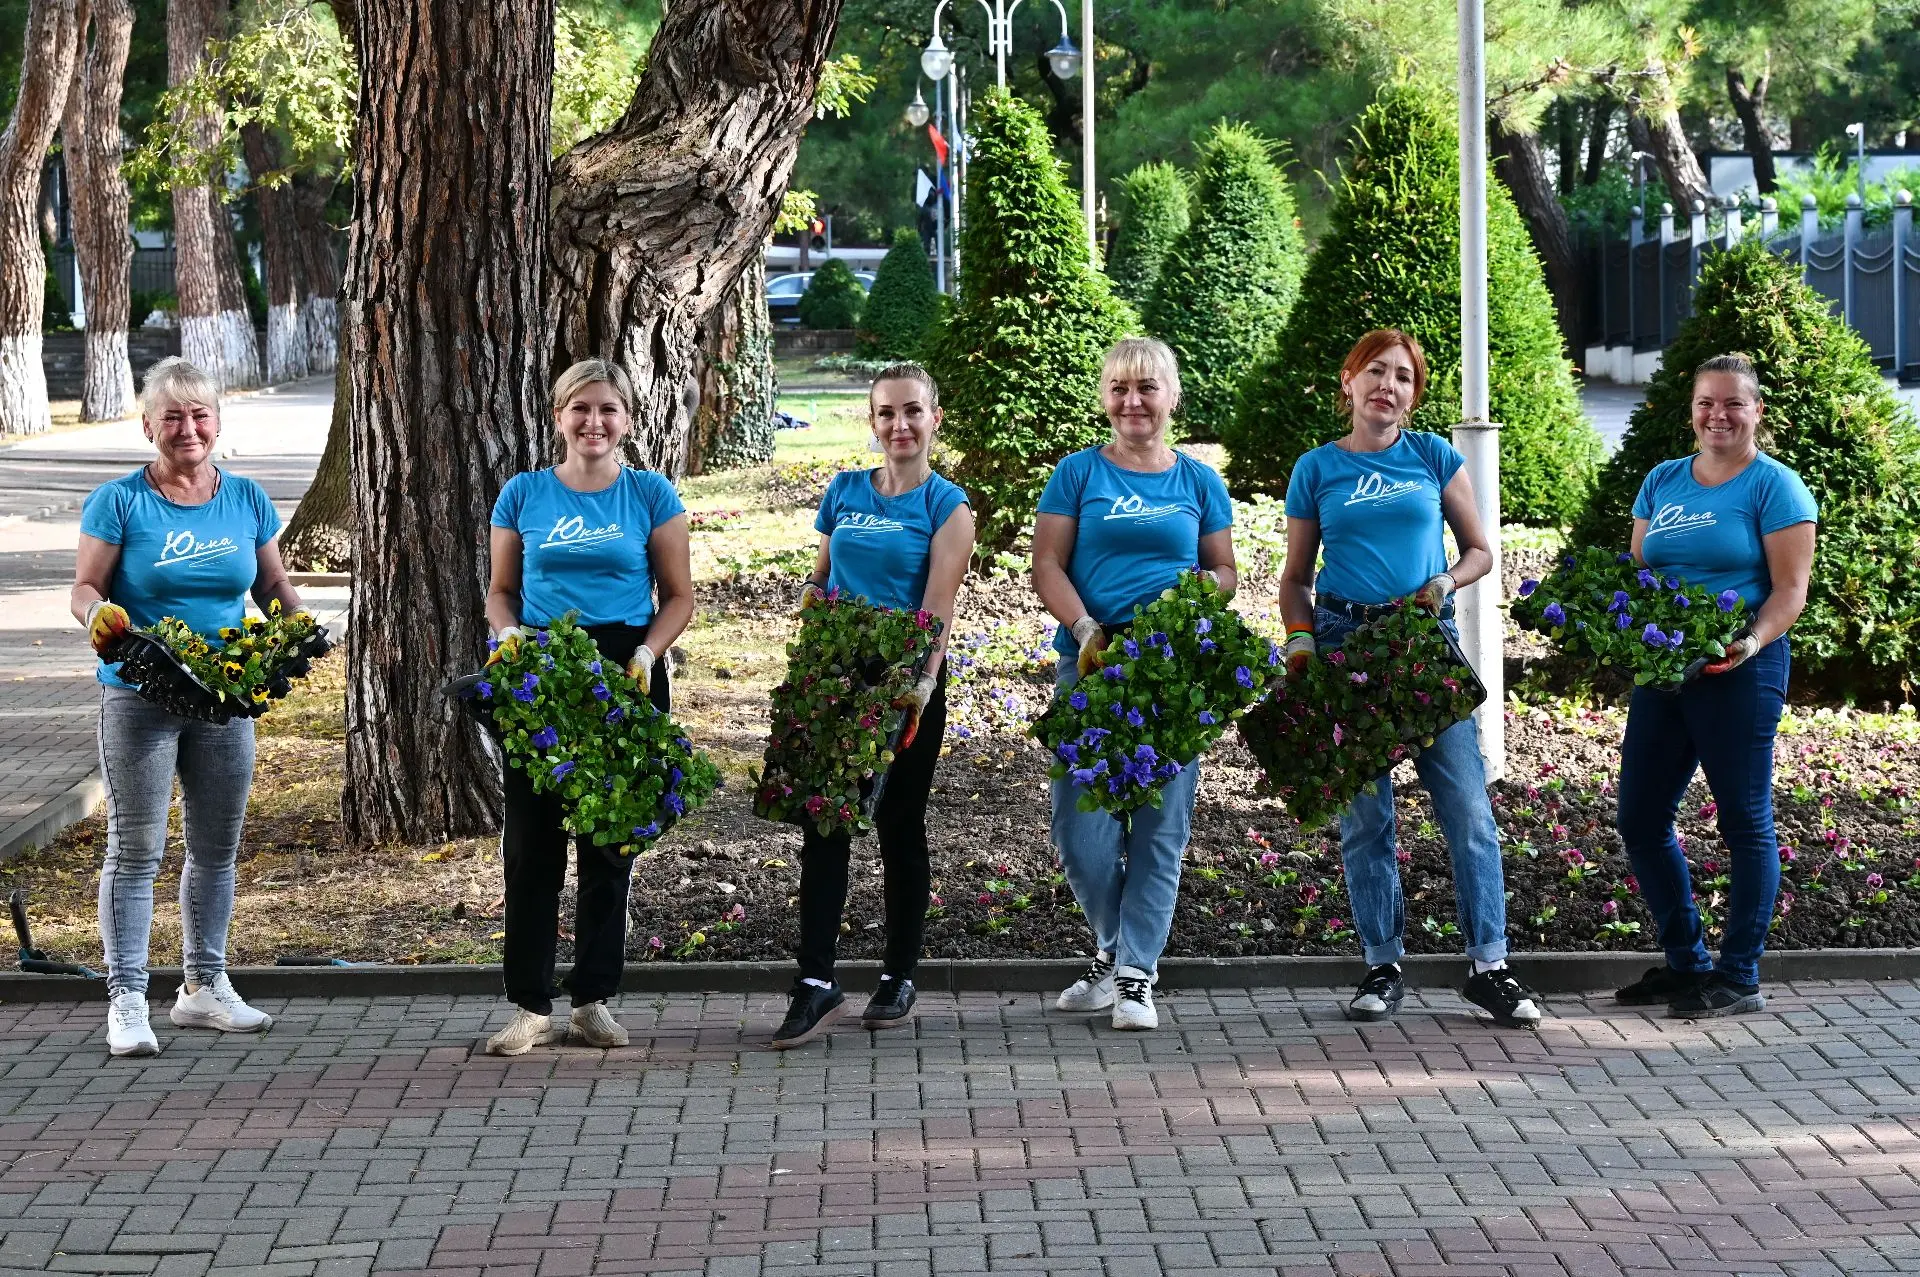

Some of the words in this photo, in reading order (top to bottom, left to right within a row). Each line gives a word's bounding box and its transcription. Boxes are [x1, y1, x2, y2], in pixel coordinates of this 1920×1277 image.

[1351, 472, 1418, 500] Юкка
[1111, 495, 1177, 515] Юкка
[1650, 503, 1715, 530] Юкка
[547, 515, 621, 542] Юкка
[161, 530, 232, 560] Юкка
